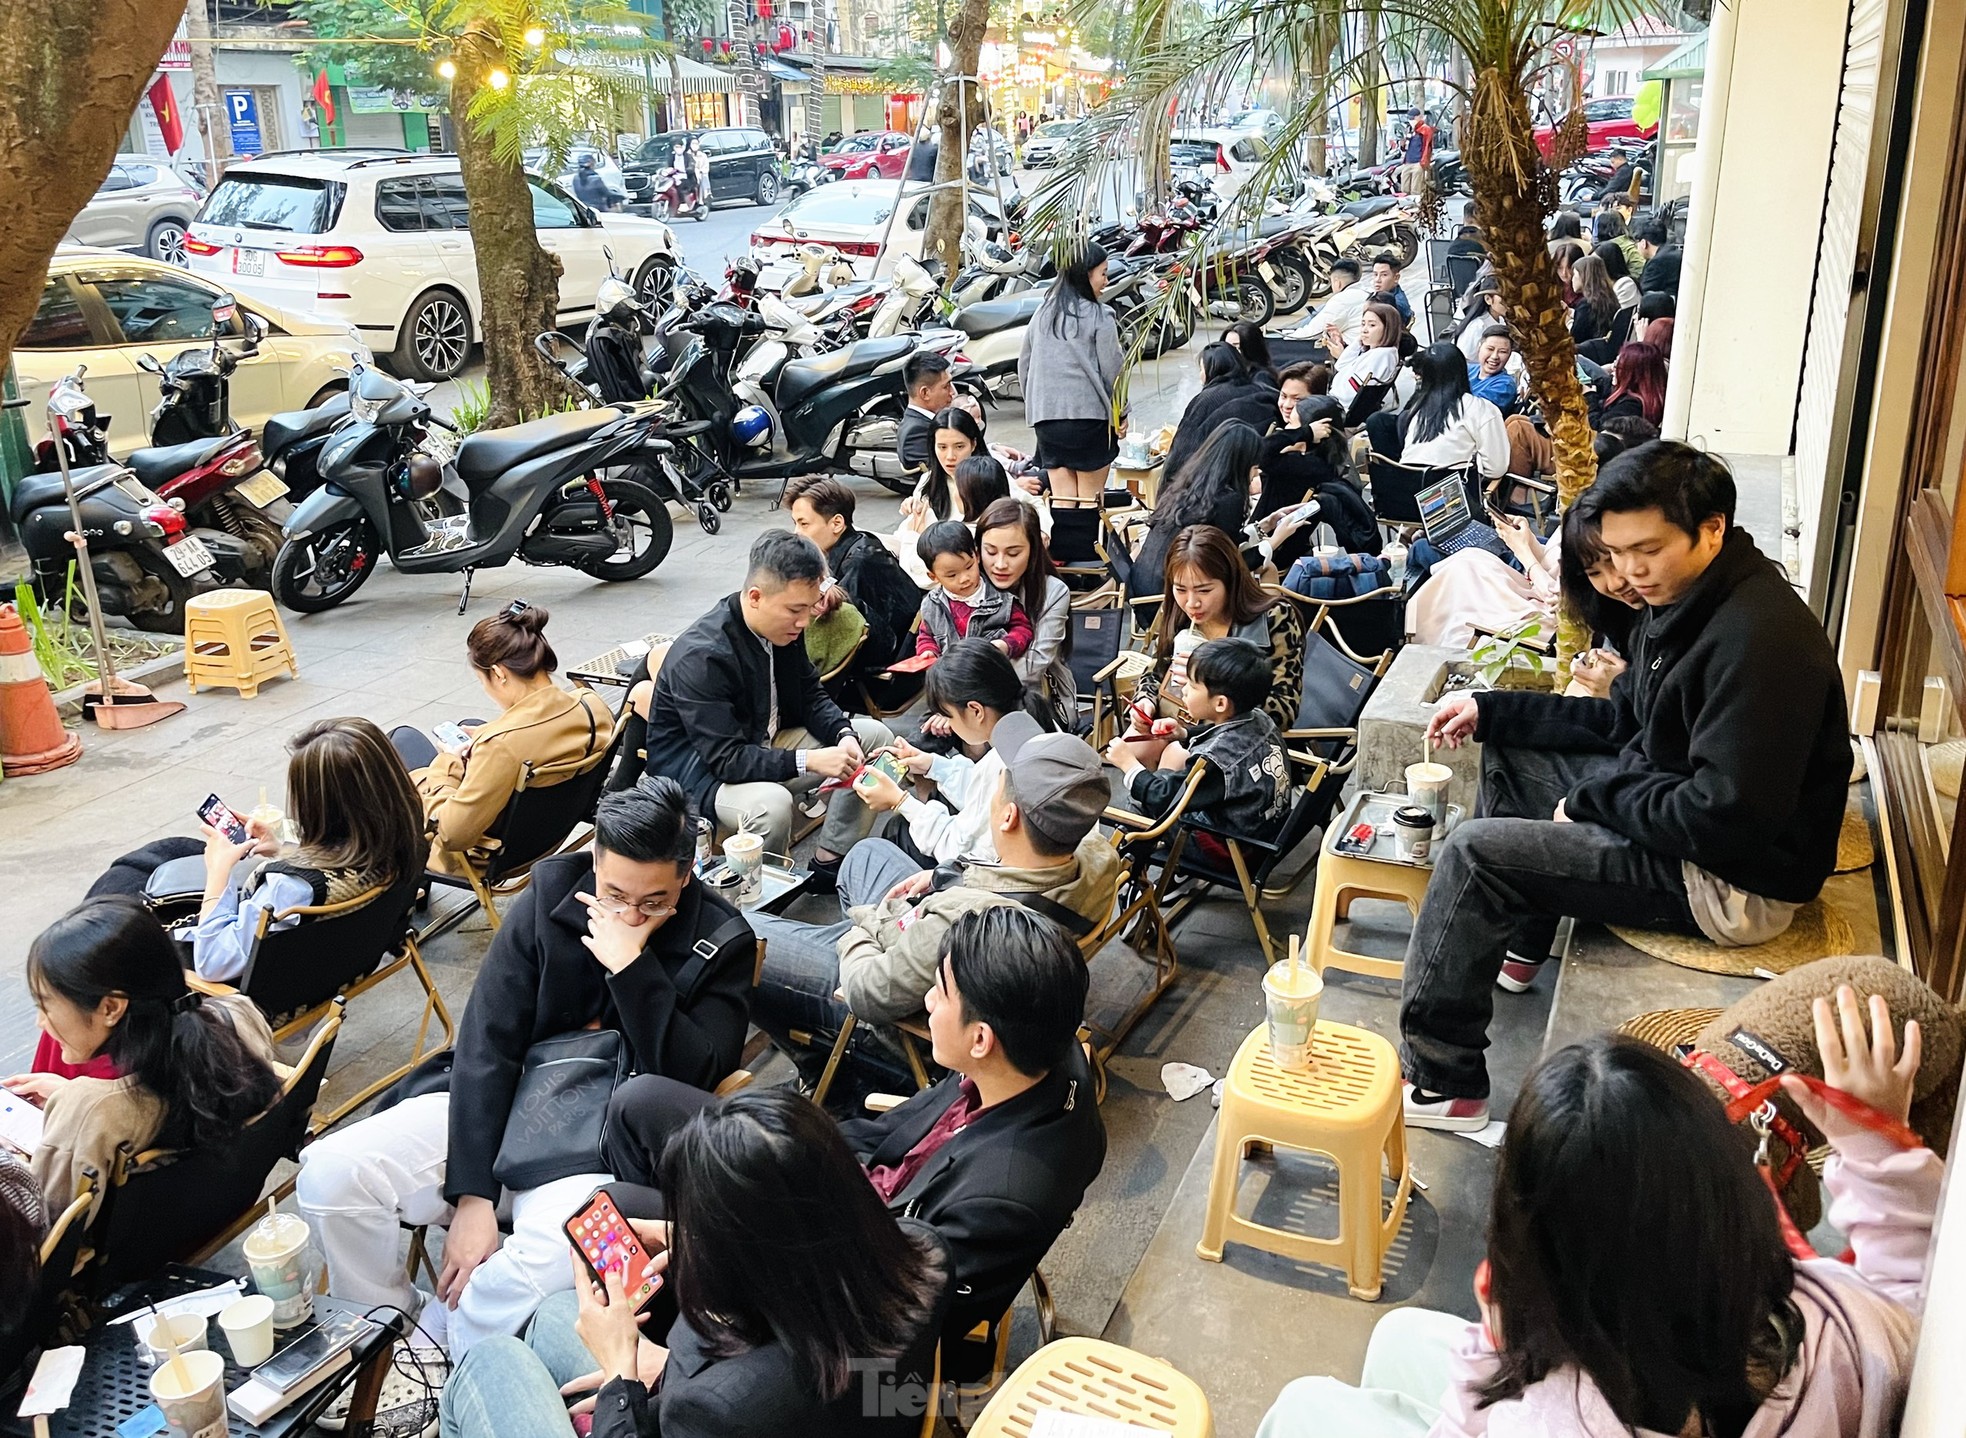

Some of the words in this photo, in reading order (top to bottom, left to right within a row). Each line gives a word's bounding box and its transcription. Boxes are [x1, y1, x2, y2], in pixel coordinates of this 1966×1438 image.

[232, 95, 248, 120] P
[170, 540, 200, 561] 29-AA
[1734, 1032, 1783, 1071] DaDaGou
[517, 1069, 567, 1120] LOUIS
[517, 1075, 599, 1144] VUITTON
[548, 1105, 586, 1137] PARIS
